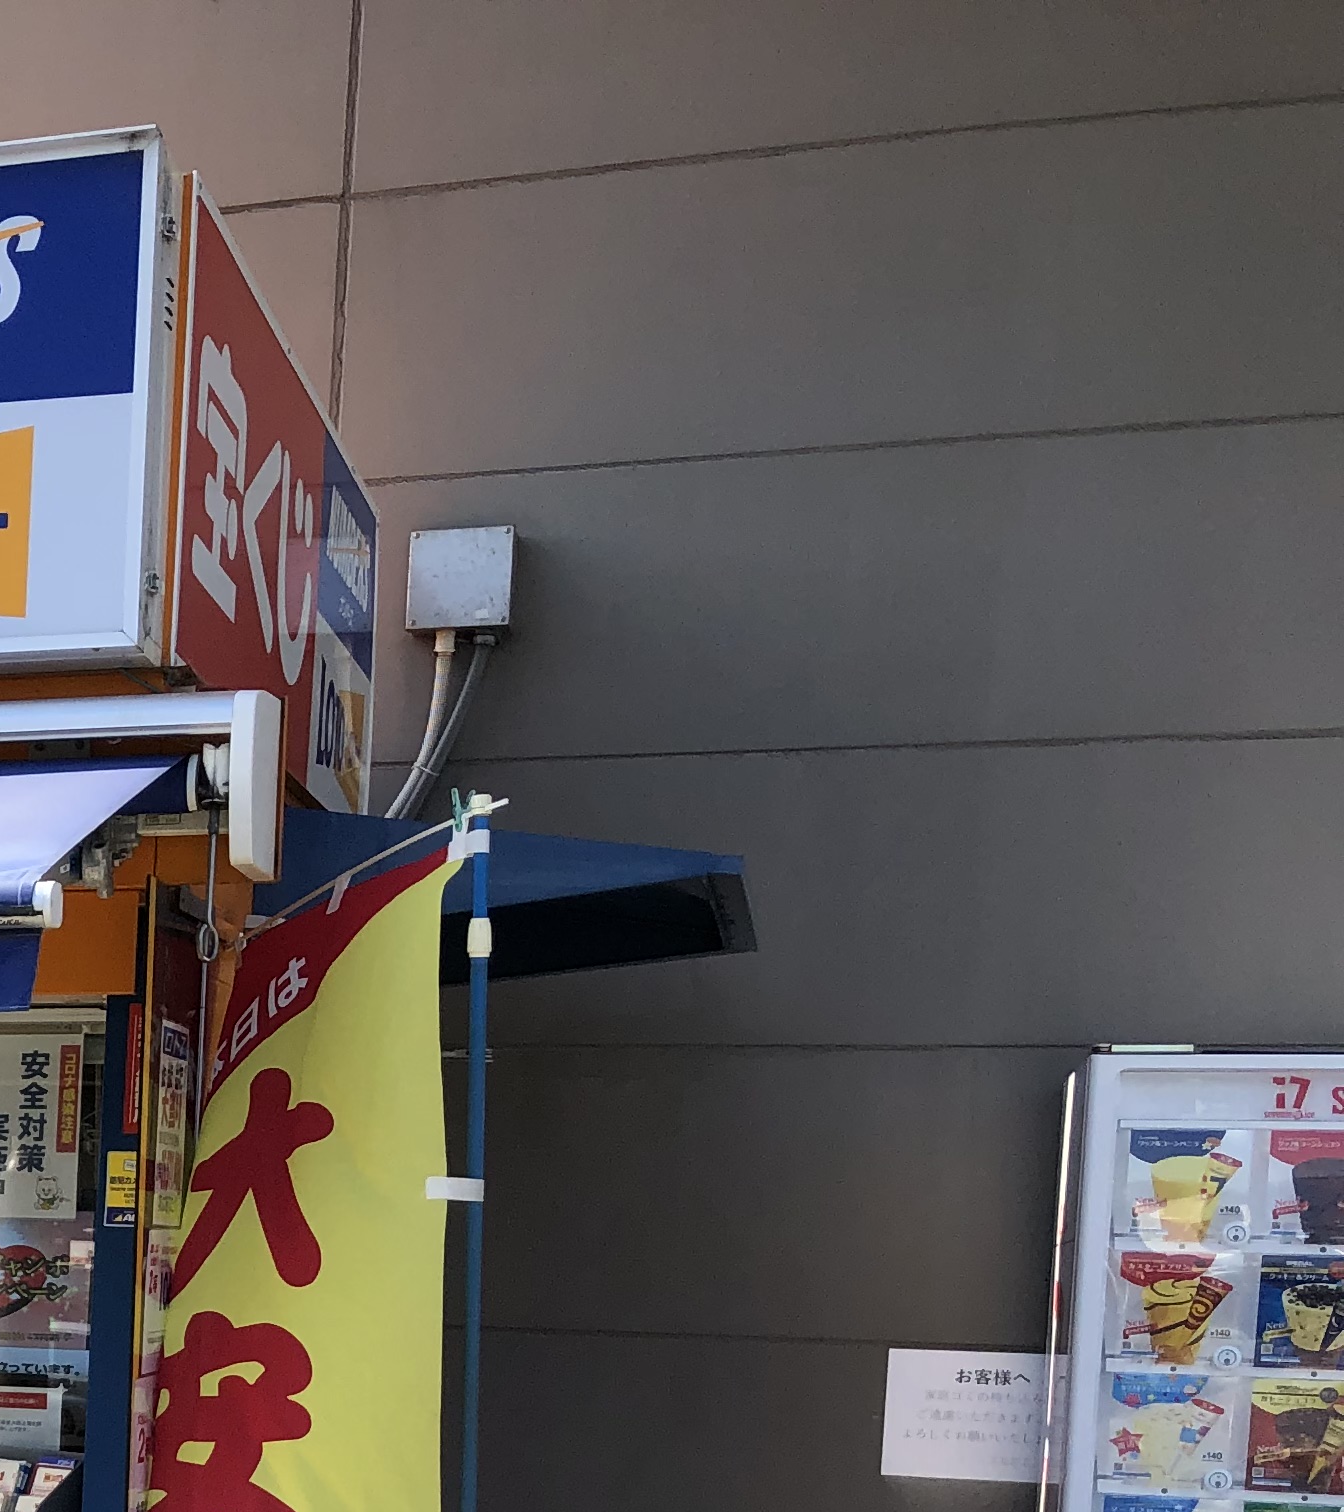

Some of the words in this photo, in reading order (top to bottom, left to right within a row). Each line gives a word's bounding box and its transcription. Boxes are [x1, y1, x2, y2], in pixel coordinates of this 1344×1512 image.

[191, 335, 313, 686] 宝くじ
[16, 1050, 51, 1173] 安全対策
[954, 1368, 1031, 1386] お客様へ
